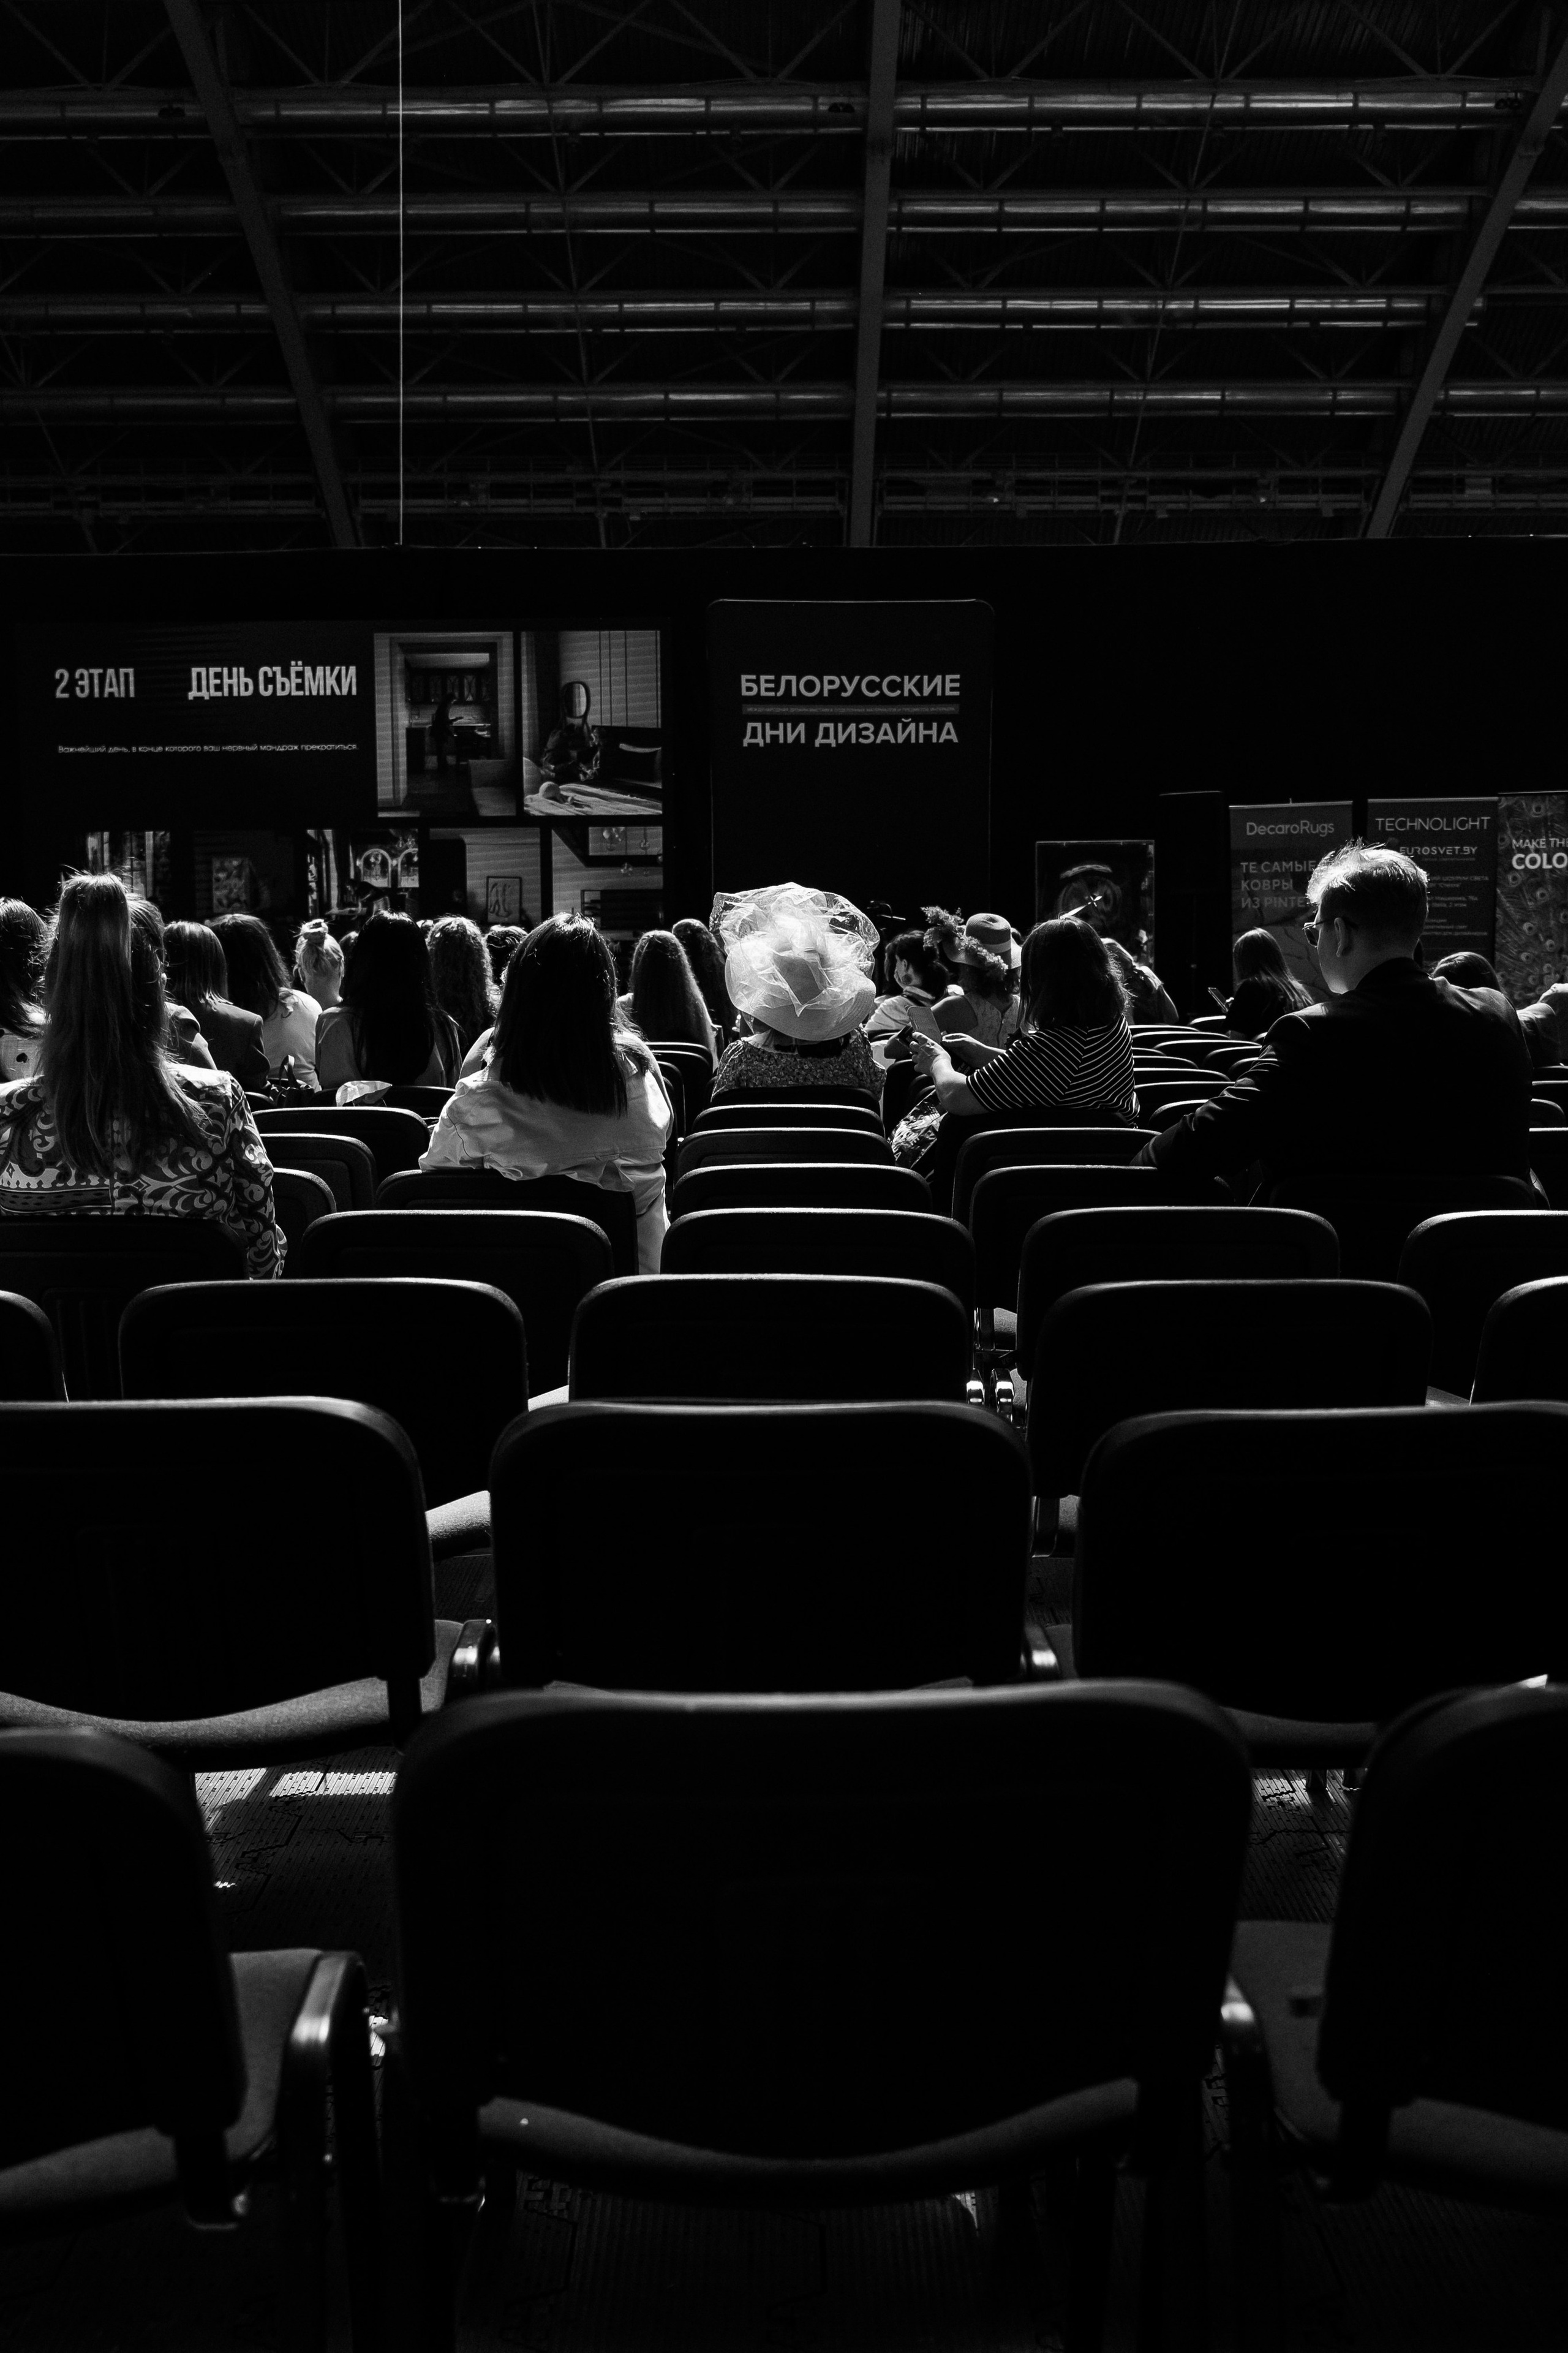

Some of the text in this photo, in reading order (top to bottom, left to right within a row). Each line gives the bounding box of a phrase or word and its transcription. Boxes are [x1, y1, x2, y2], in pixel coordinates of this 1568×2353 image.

[55, 668, 134, 698] 2 ЭТАП
[188, 661, 356, 700] ДЕНЬ СЪЁМКИ
[741, 674, 960, 697] БЕЛОРУССКИЕ
[743, 719, 958, 747] ДНИ ДИЗАЙНА
[222, 744, 257, 753] нервный
[1246, 820, 1335, 837] DecaroRugs
[1375, 817, 1491, 831] TECHNOLIGHT
[1512, 837, 1547, 848] MAKE
[1240, 860, 1316, 874] ТЕ САМЫЕ
[1511, 852, 1568, 871] COLO
[1241, 879, 1293, 891] КОВРЫ
[1242, 896, 1310, 908] ИЗ PINTE
